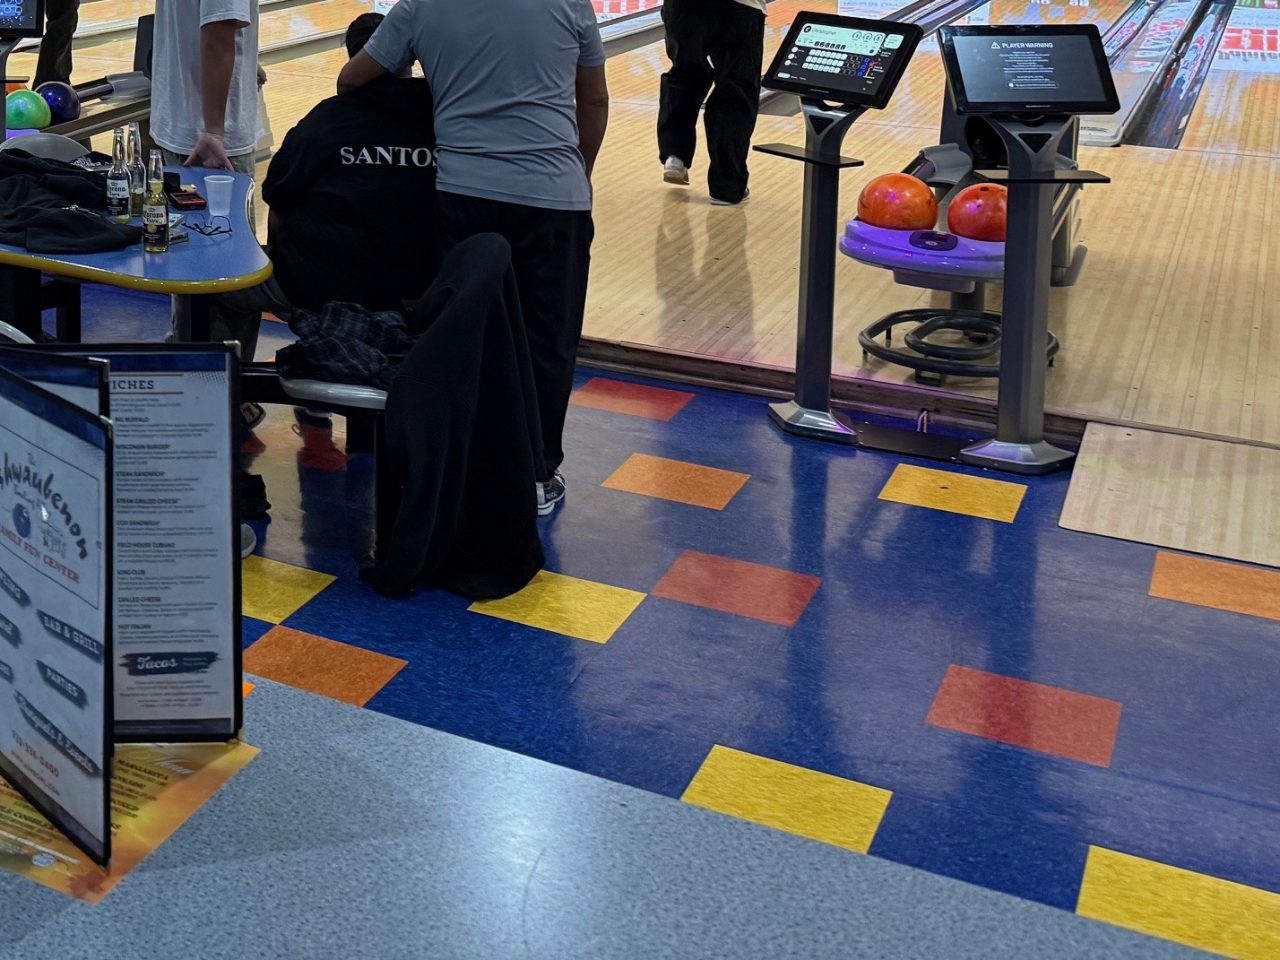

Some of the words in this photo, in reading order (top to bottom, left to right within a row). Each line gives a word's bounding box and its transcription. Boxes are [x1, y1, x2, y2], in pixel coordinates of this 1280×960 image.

[43, 554, 80, 583] CENTER
[43, 616, 61, 632] BAR
[72, 630, 99, 655] GRILL
[137, 655, 179, 670] Tacos
[46, 667, 78, 698] PARTIES
[117, 759, 169, 781] MARGARITA
